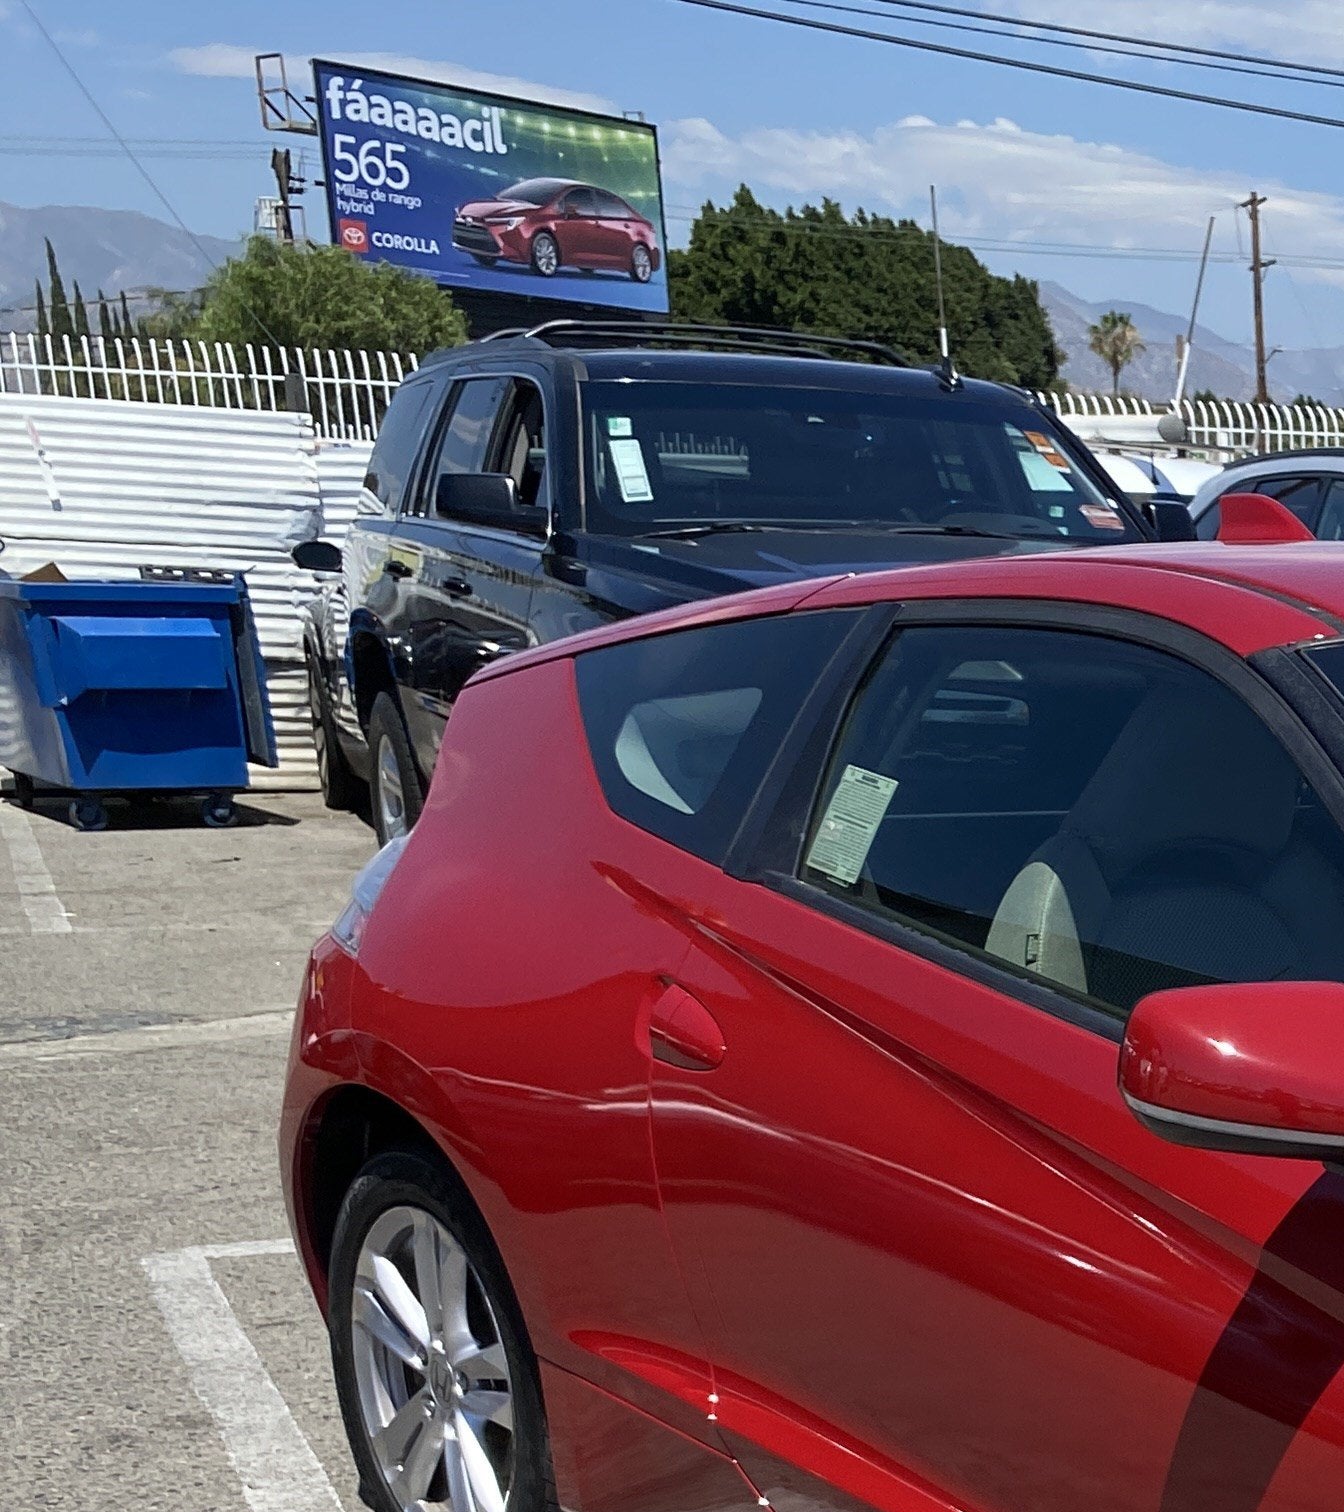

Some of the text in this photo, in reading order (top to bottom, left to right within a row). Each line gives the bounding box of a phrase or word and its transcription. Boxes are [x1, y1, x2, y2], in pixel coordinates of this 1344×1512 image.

[326, 76, 507, 155] fáaaaacil
[334, 133, 410, 191] 565
[335, 182, 423, 210] Millas de rango
[336, 196, 376, 216] hybrid
[371, 231, 441, 256] COROLLA
